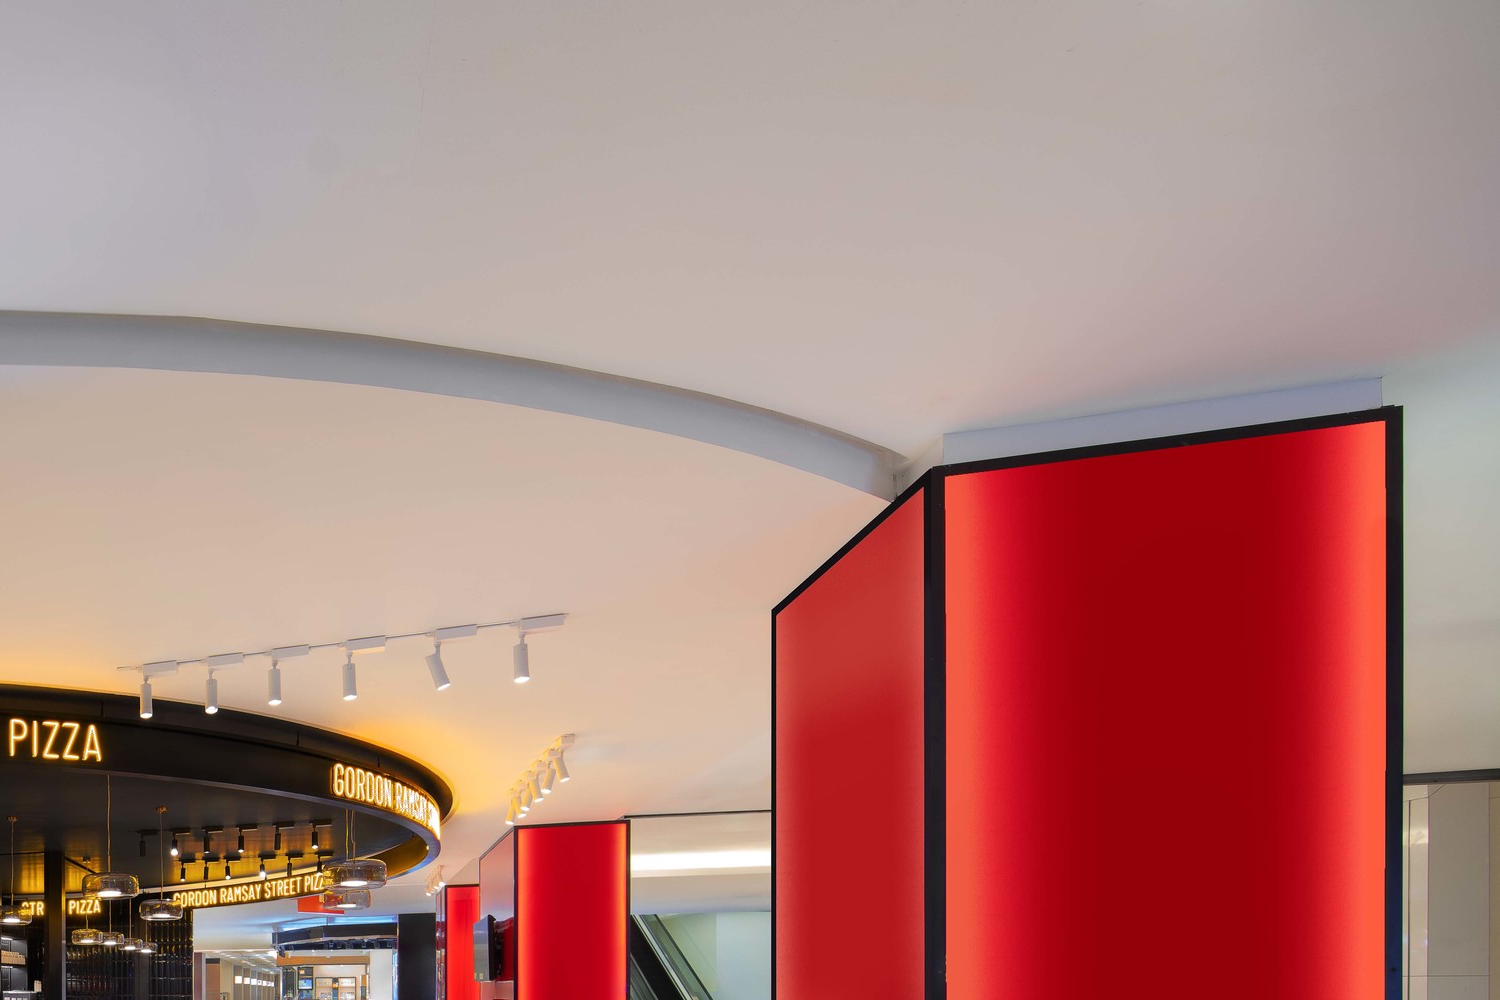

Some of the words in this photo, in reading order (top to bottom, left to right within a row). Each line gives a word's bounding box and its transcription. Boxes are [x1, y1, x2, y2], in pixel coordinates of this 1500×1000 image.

[8, 717, 103, 762] PIZZA
[333, 763, 393, 808] GORDON
[395, 782, 428, 824] RAMSAY
[68, 899, 101, 915] PIZZA
[172, 889, 217, 908] GORDON
[219, 883, 262, 903] RAMSAY
[264, 876, 302, 899] STREET
[304, 872, 326, 893] PIZZ
